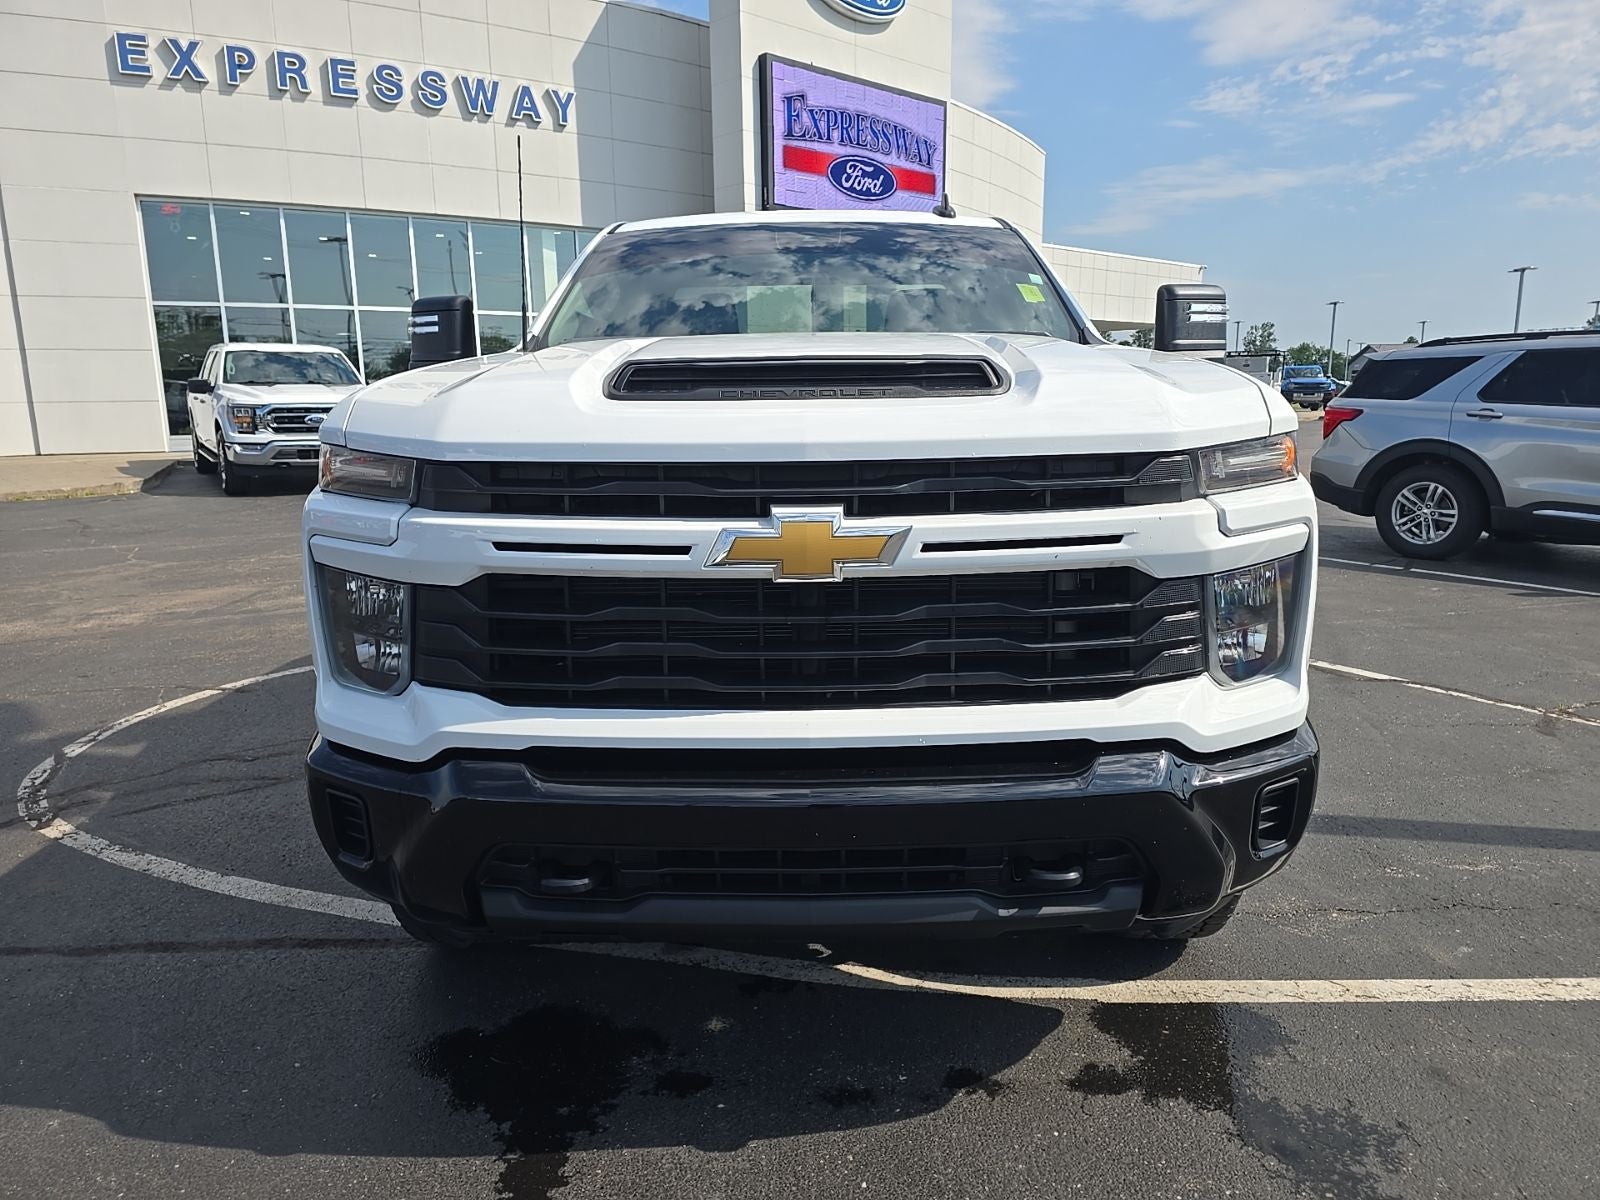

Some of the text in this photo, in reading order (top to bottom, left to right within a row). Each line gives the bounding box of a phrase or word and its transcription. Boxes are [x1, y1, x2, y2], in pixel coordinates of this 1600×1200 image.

[113, 31, 577, 125] EXPRESSWAY
[782, 93, 937, 167] EXPRESSWAY
[841, 161, 885, 195] Ford
[719, 388, 893, 399] CHEVROLET
